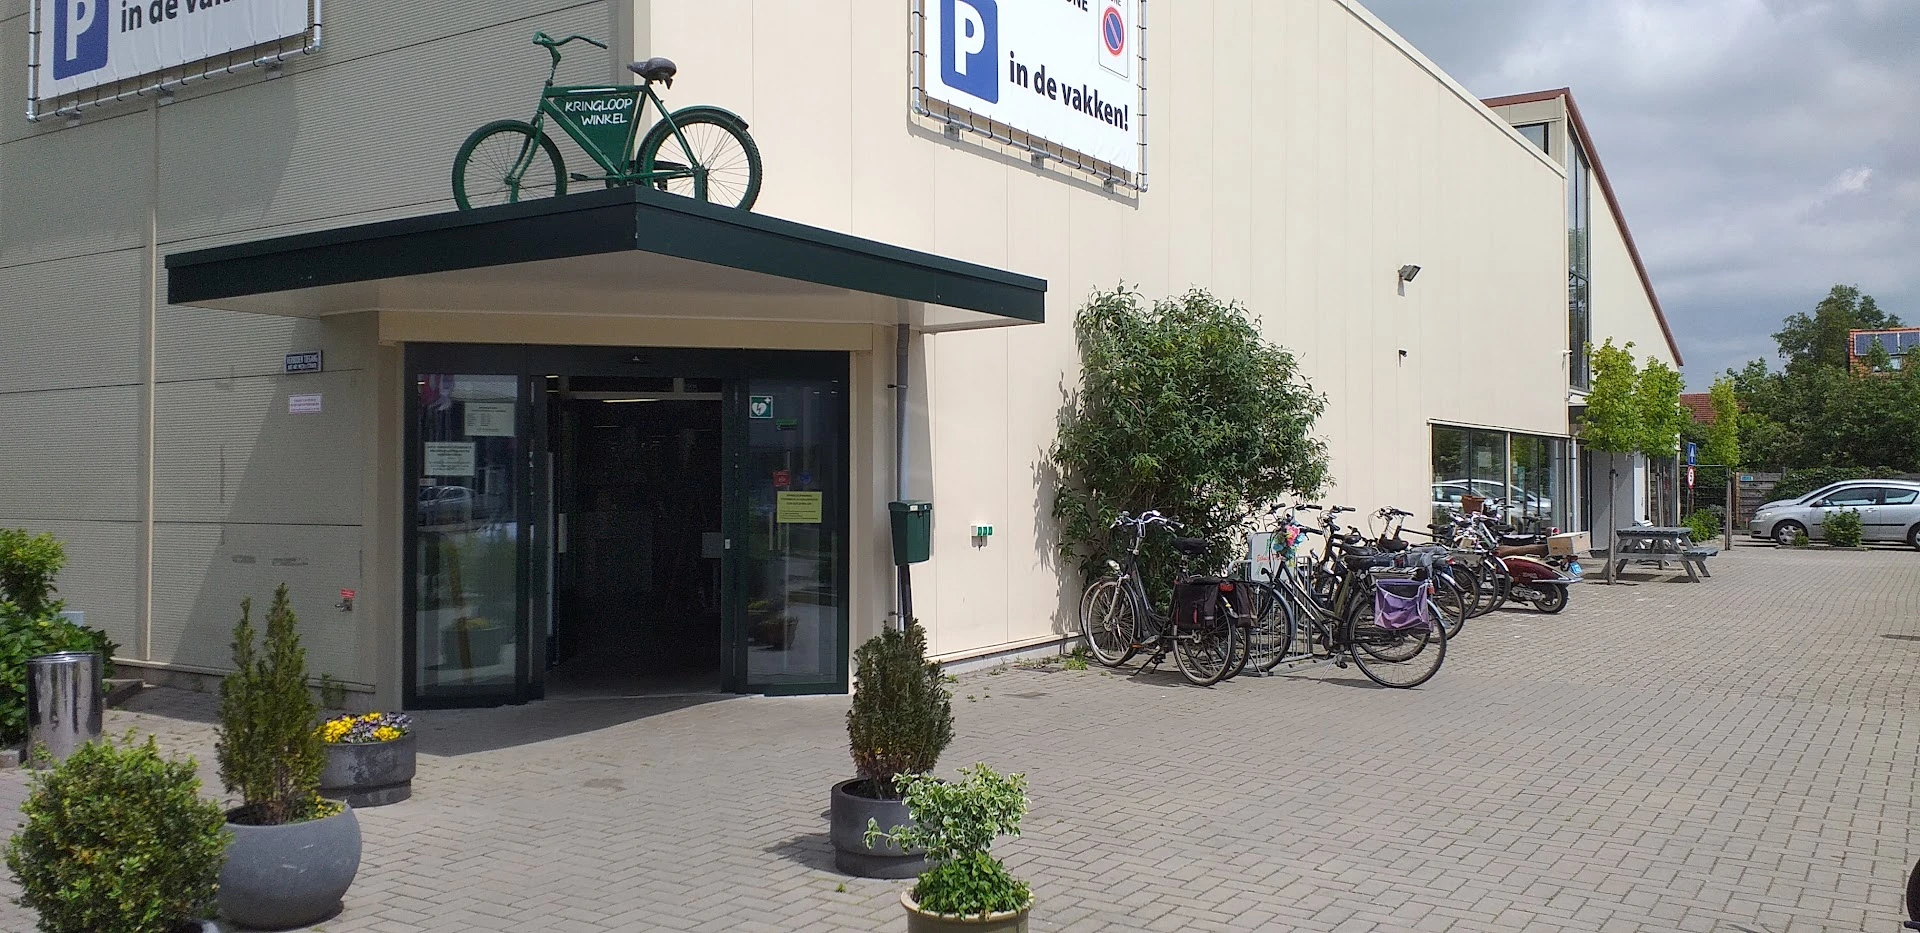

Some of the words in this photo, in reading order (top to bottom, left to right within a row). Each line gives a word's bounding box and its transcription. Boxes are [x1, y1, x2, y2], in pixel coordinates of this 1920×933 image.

[66, 0, 97, 61] P
[121, 0, 142, 33] in
[954, 0, 985, 76] P
[565, 98, 633, 112] KRINGLOOP
[1009, 50, 1028, 89] in
[1033, 64, 1057, 101] de
[1061, 82, 1129, 132] vakken!
[581, 113, 628, 126] WINKEL
